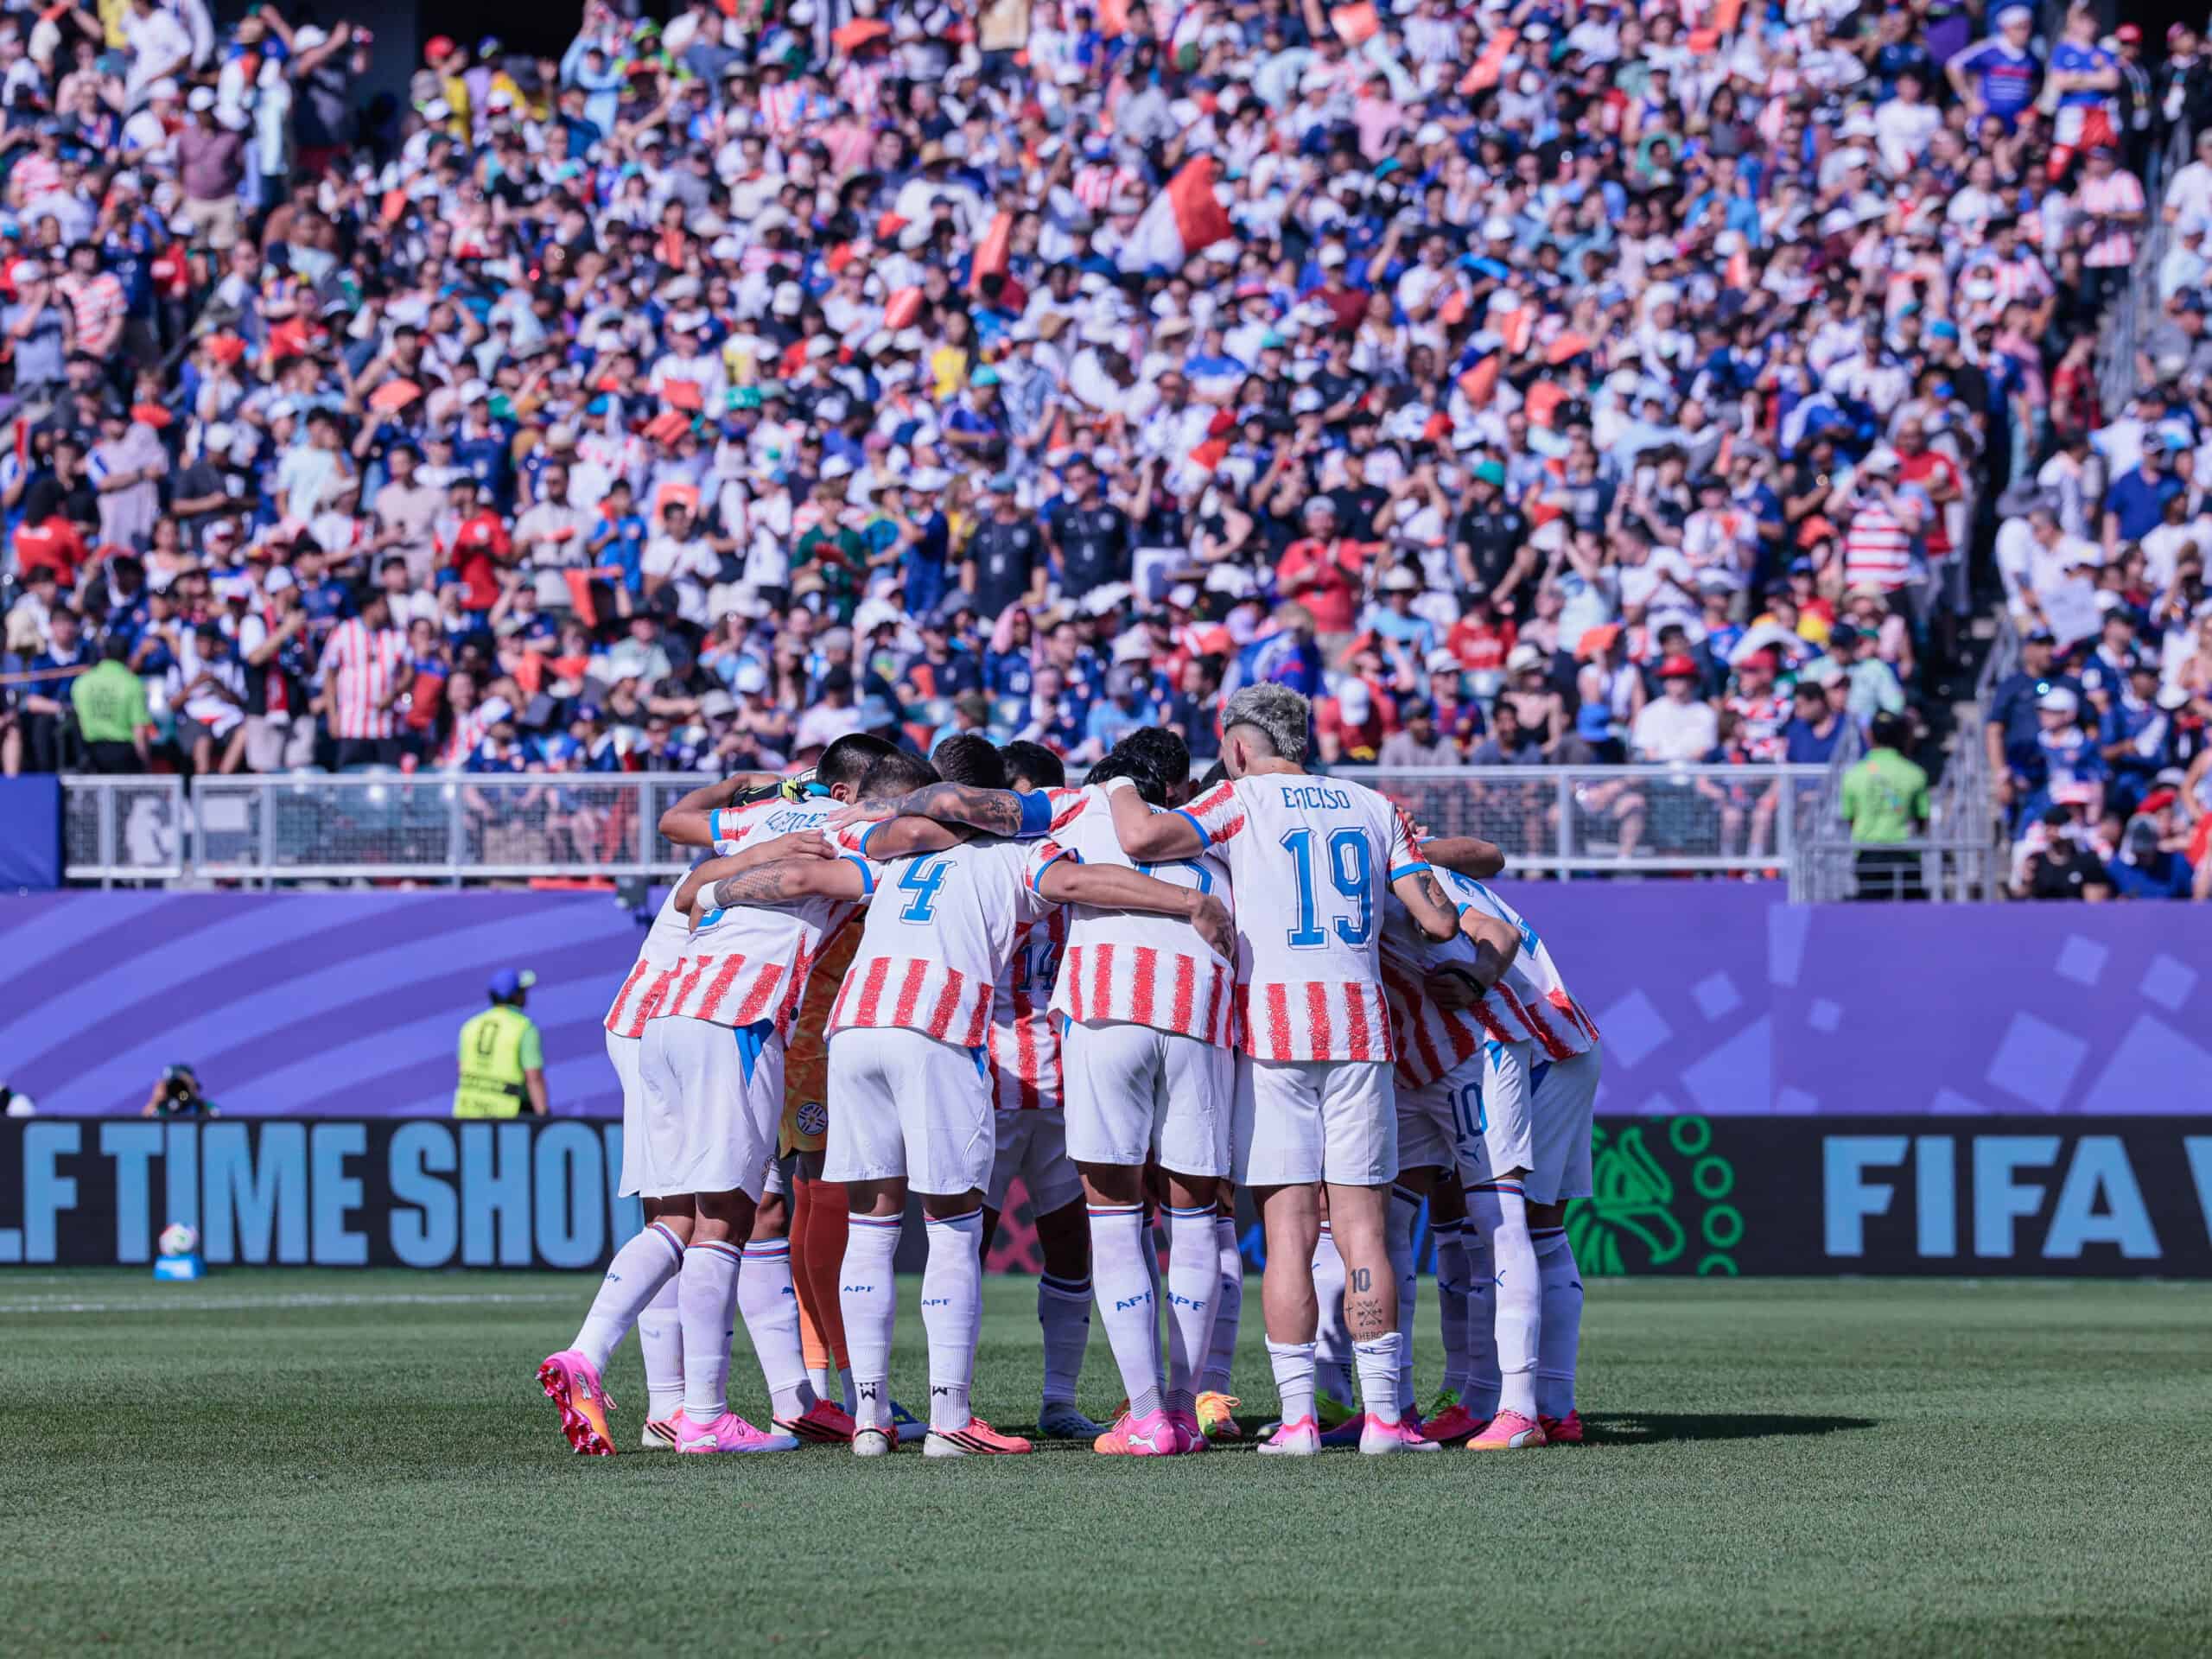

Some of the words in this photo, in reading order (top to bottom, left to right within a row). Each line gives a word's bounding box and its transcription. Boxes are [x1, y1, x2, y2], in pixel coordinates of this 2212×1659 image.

[1281, 786, 1351, 810] ENCISO
[898, 852, 959, 925] 4
[1279, 825, 1374, 953] 19
[1017, 940, 1058, 993] 14
[1447, 1083, 1488, 1145] 10
[100, 1122, 370, 1265] TIME
[1823, 1135, 2164, 1258] FIFA
[1350, 1268, 1372, 1294] 10
